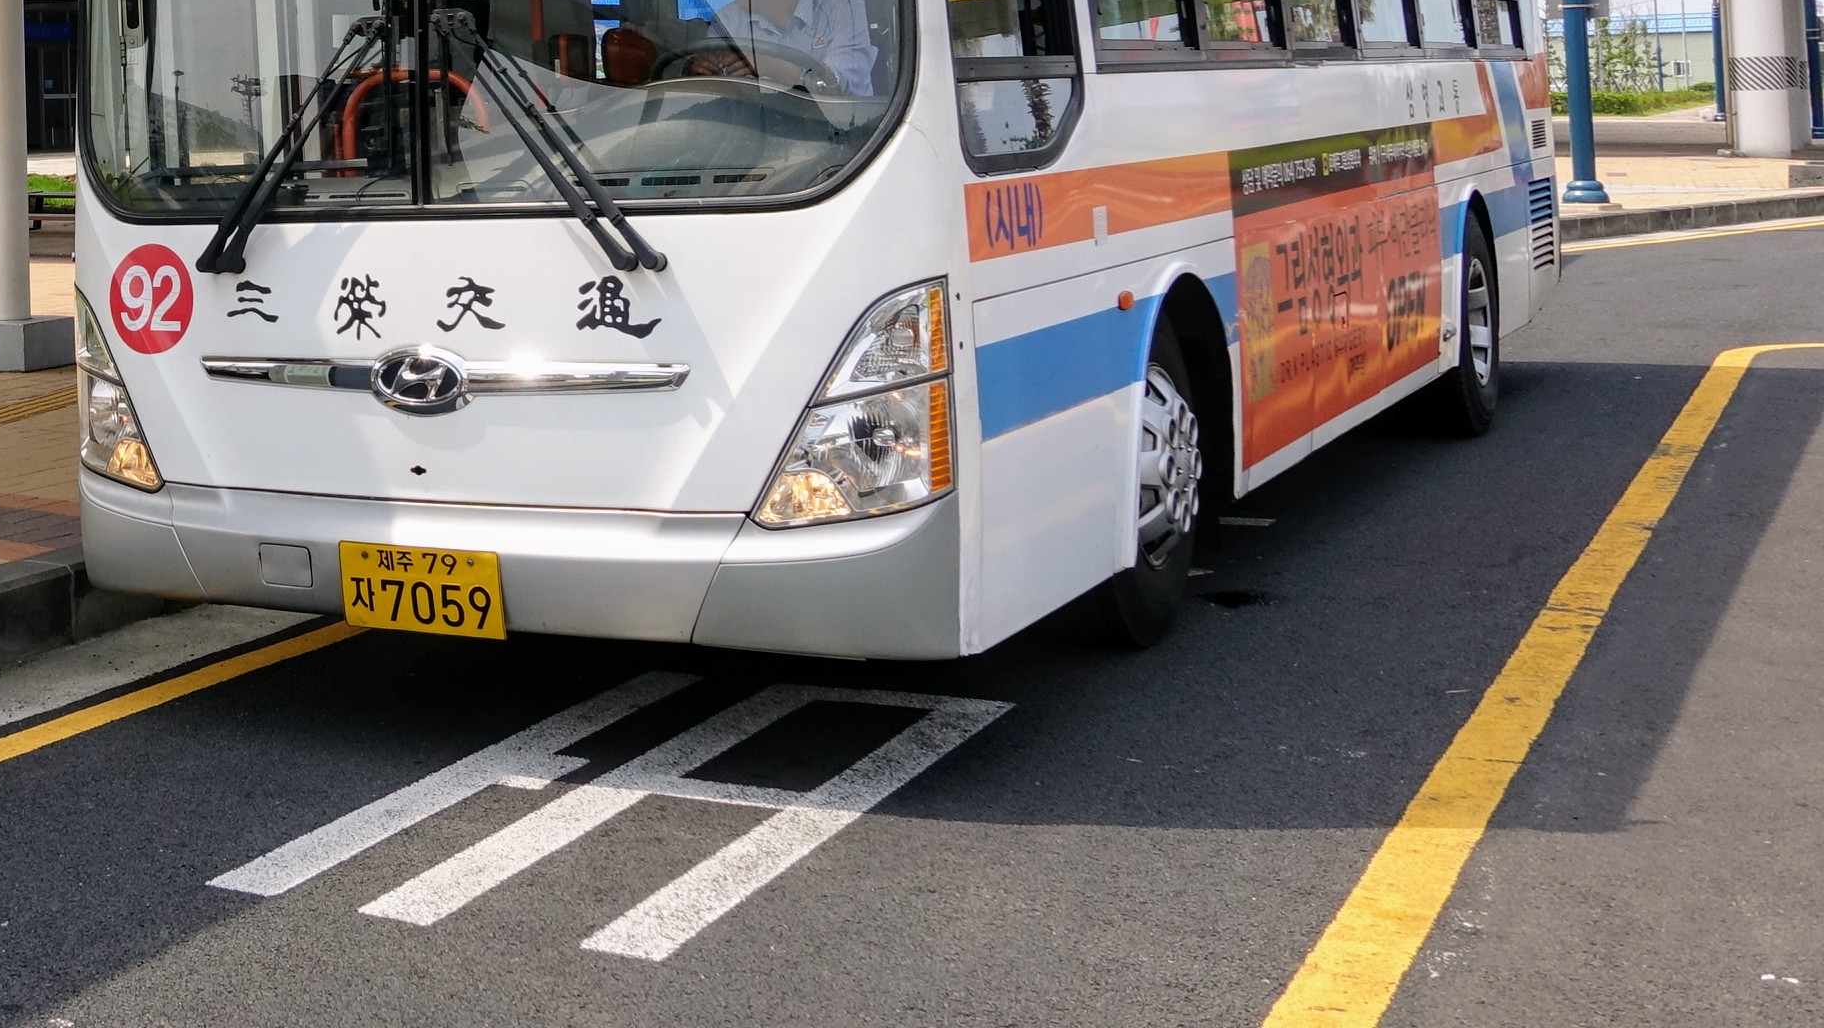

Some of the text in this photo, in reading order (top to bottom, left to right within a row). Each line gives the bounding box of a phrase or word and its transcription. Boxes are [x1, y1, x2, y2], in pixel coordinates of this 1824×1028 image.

[985, 181, 1043, 250] (시내)
[117, 264, 183, 333] 92
[1386, 270, 1426, 352] OPEN
[376, 549, 458, 575] 제주 79
